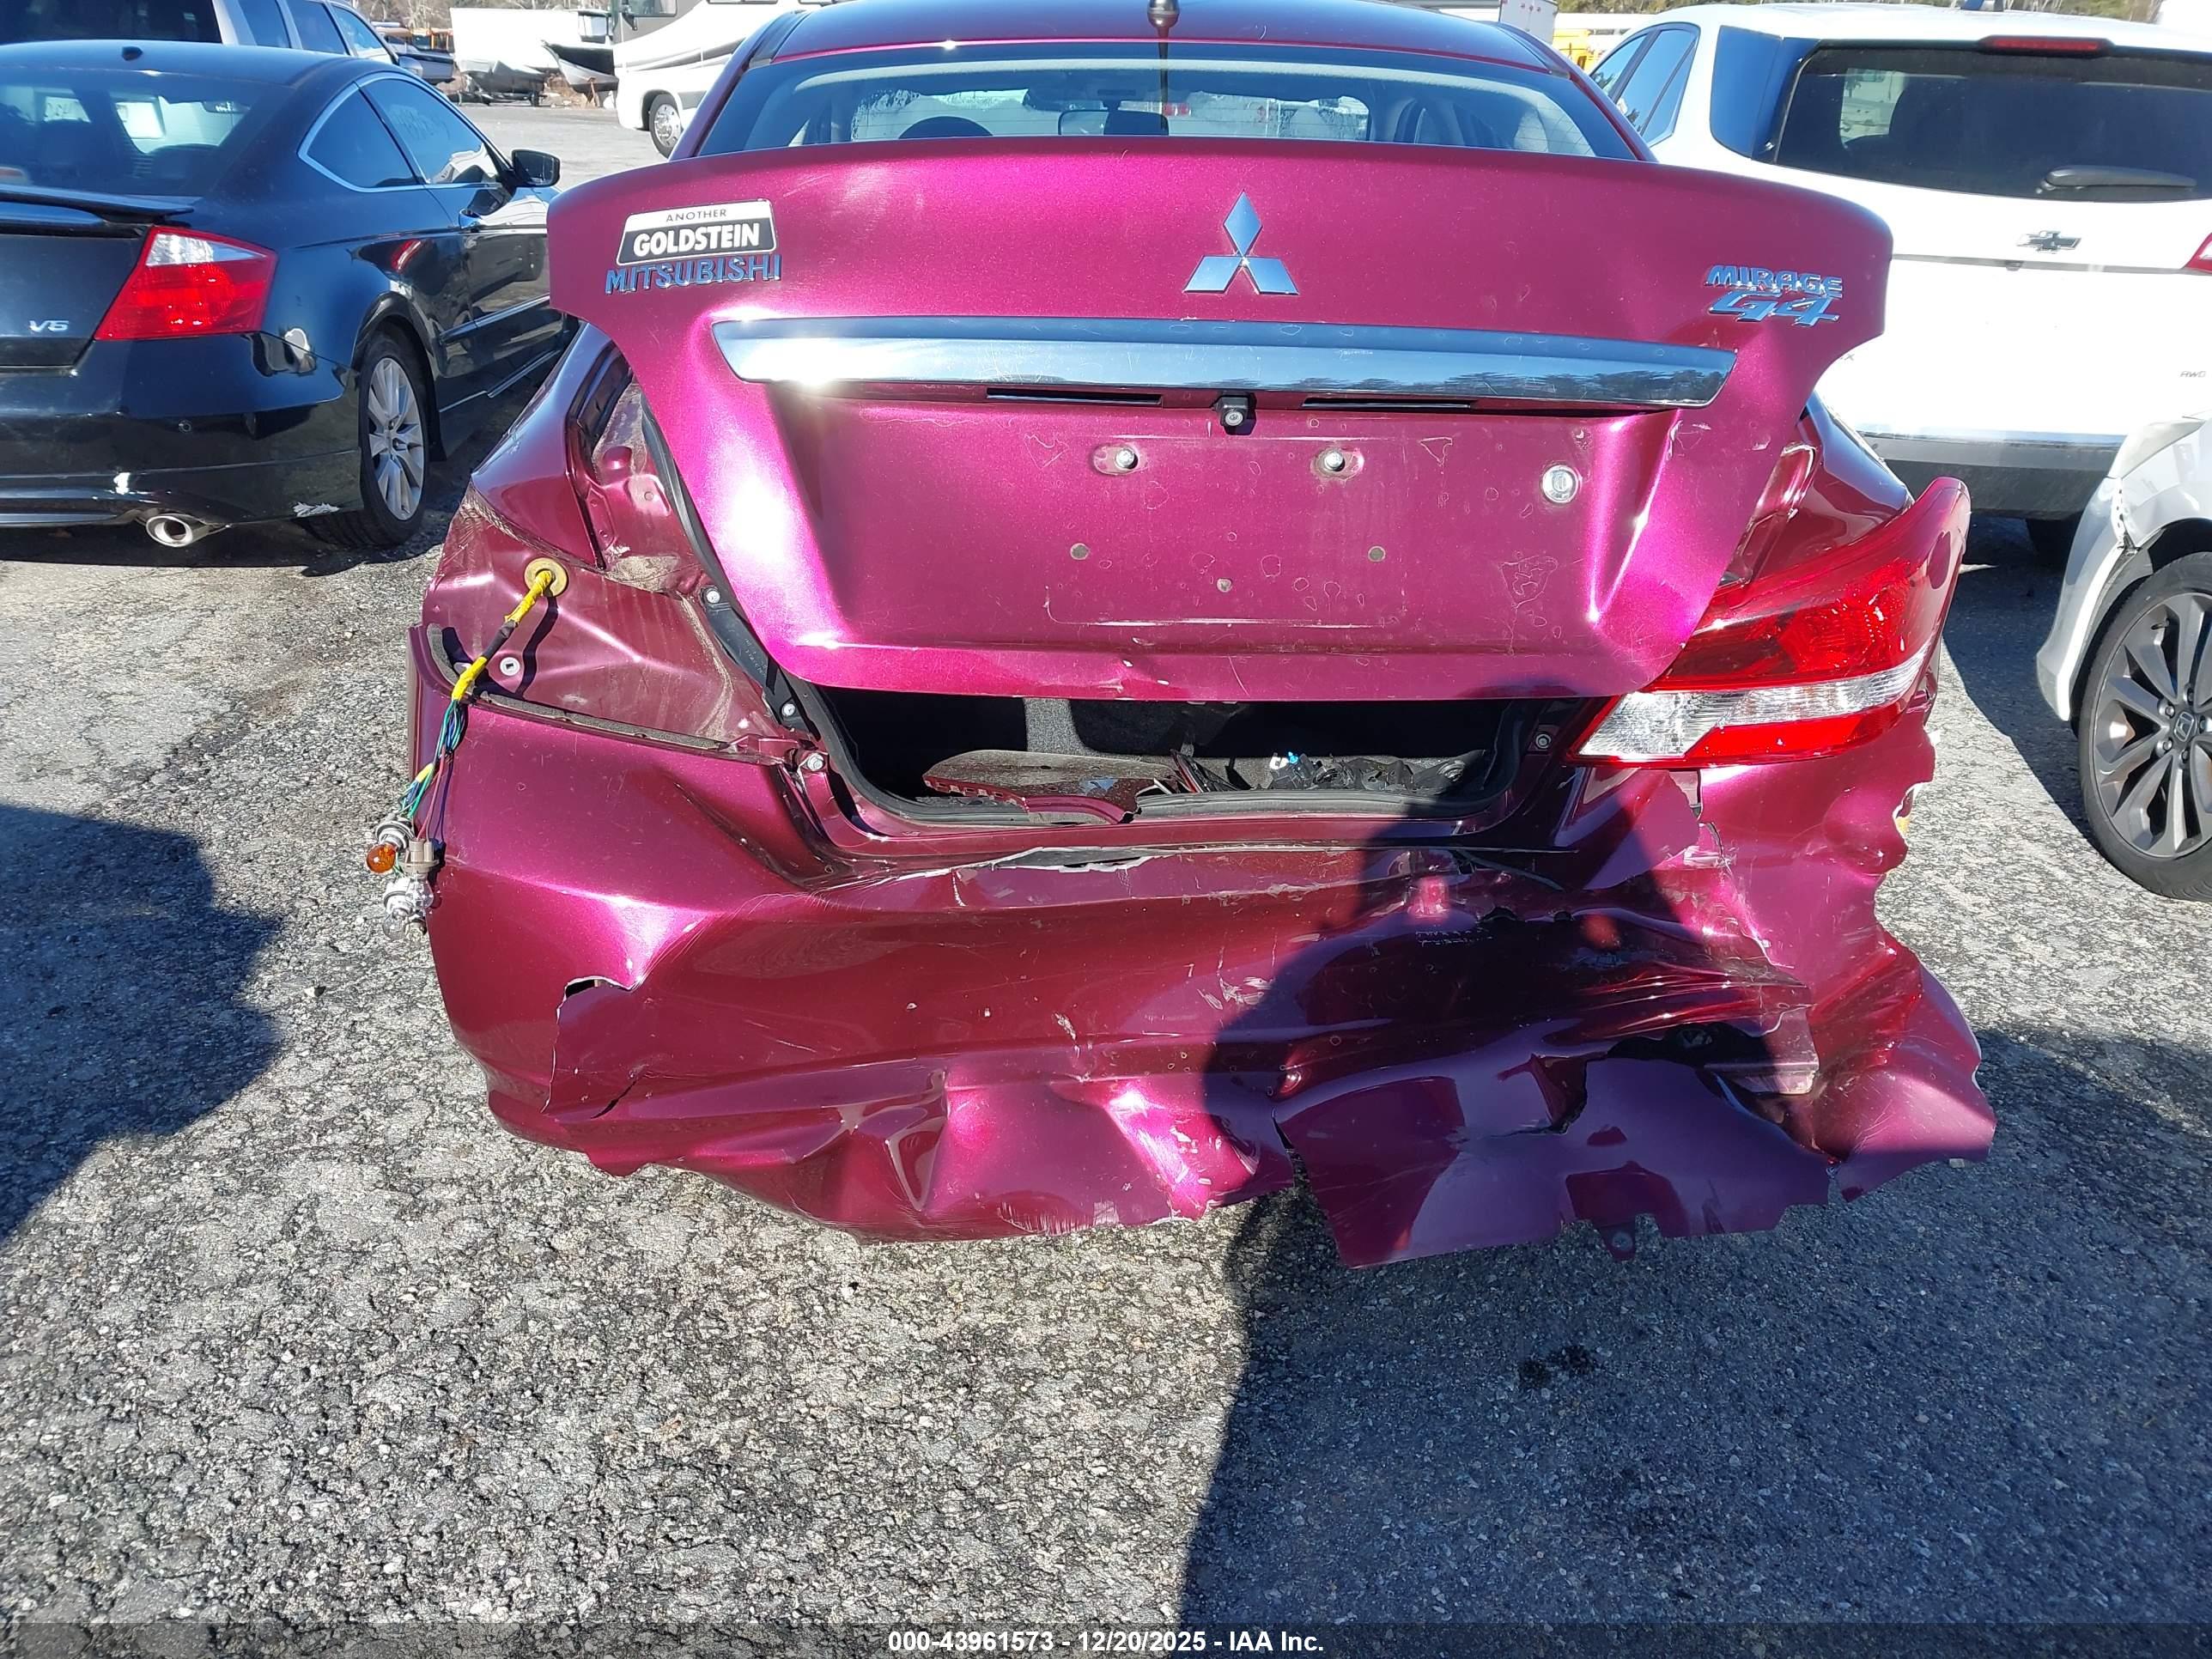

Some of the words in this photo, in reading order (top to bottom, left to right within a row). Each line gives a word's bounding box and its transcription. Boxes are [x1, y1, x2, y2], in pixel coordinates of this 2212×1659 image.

[665, 209, 728, 222] ANOTHER
[633, 222, 760, 258] GOLDSTEIN
[605, 253, 782, 295] MITSUBISHI
[1704, 264, 1844, 298] MIRAGE
[1707, 289, 1841, 326] G4
[29, 319, 70, 333] V6
